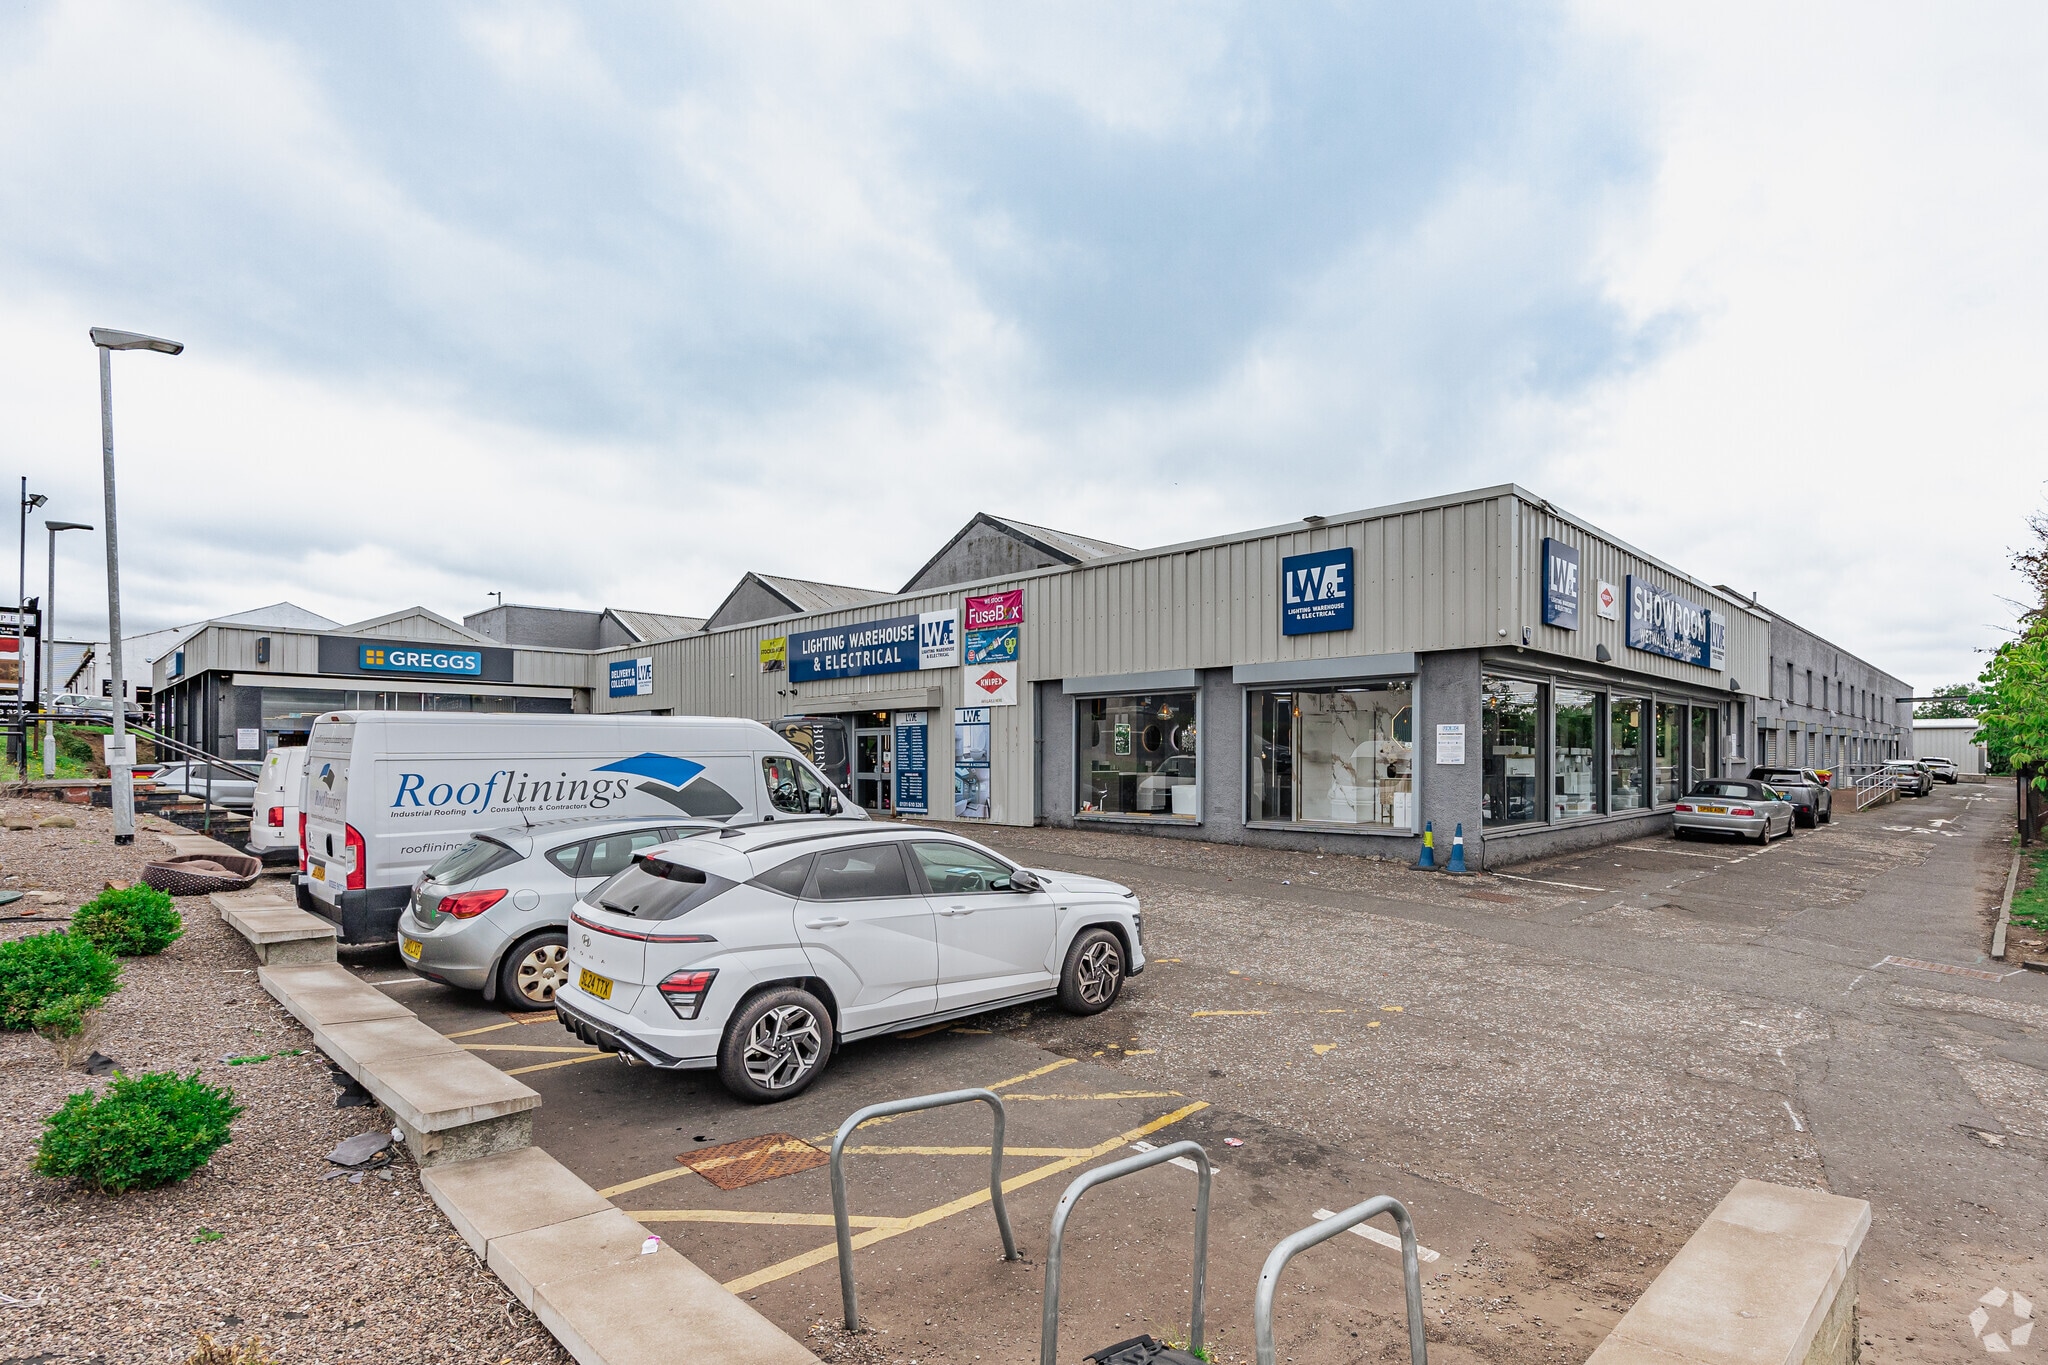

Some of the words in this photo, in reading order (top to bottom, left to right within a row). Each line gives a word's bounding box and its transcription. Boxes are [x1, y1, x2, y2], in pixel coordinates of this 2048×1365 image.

[1286, 563, 1346, 604] LW&E
[1288, 606, 1311, 615] LIGHTING
[1312, 602, 1345, 612] WAREHOUSE
[1302, 610, 1336, 619] ELECTRICAL
[1634, 585, 1706, 643] SHOWROOM
[802, 634, 845, 655] LIGHTING
[849, 624, 915, 648] WAREHOUSE
[921, 619, 955, 648] LW&E
[389, 651, 476, 670] GREGGS
[813, 656, 821, 672] &
[825, 647, 902, 671] ELECTRICAL
[611, 669, 631, 679] DELIVERY
[980, 677, 1003, 687] KNIPEX
[611, 677, 636, 689] COLLECTION
[390, 770, 630, 815] Rooflinings
[390, 810, 433, 818] Industrial
[433, 808, 467, 818] Roofing
[490, 805, 536, 813] Consultants
[537, 804, 544, 812] &
[545, 802, 588, 811] Contractors
[581, 971, 596, 991] SL24
[595, 978, 610, 997] TTX
